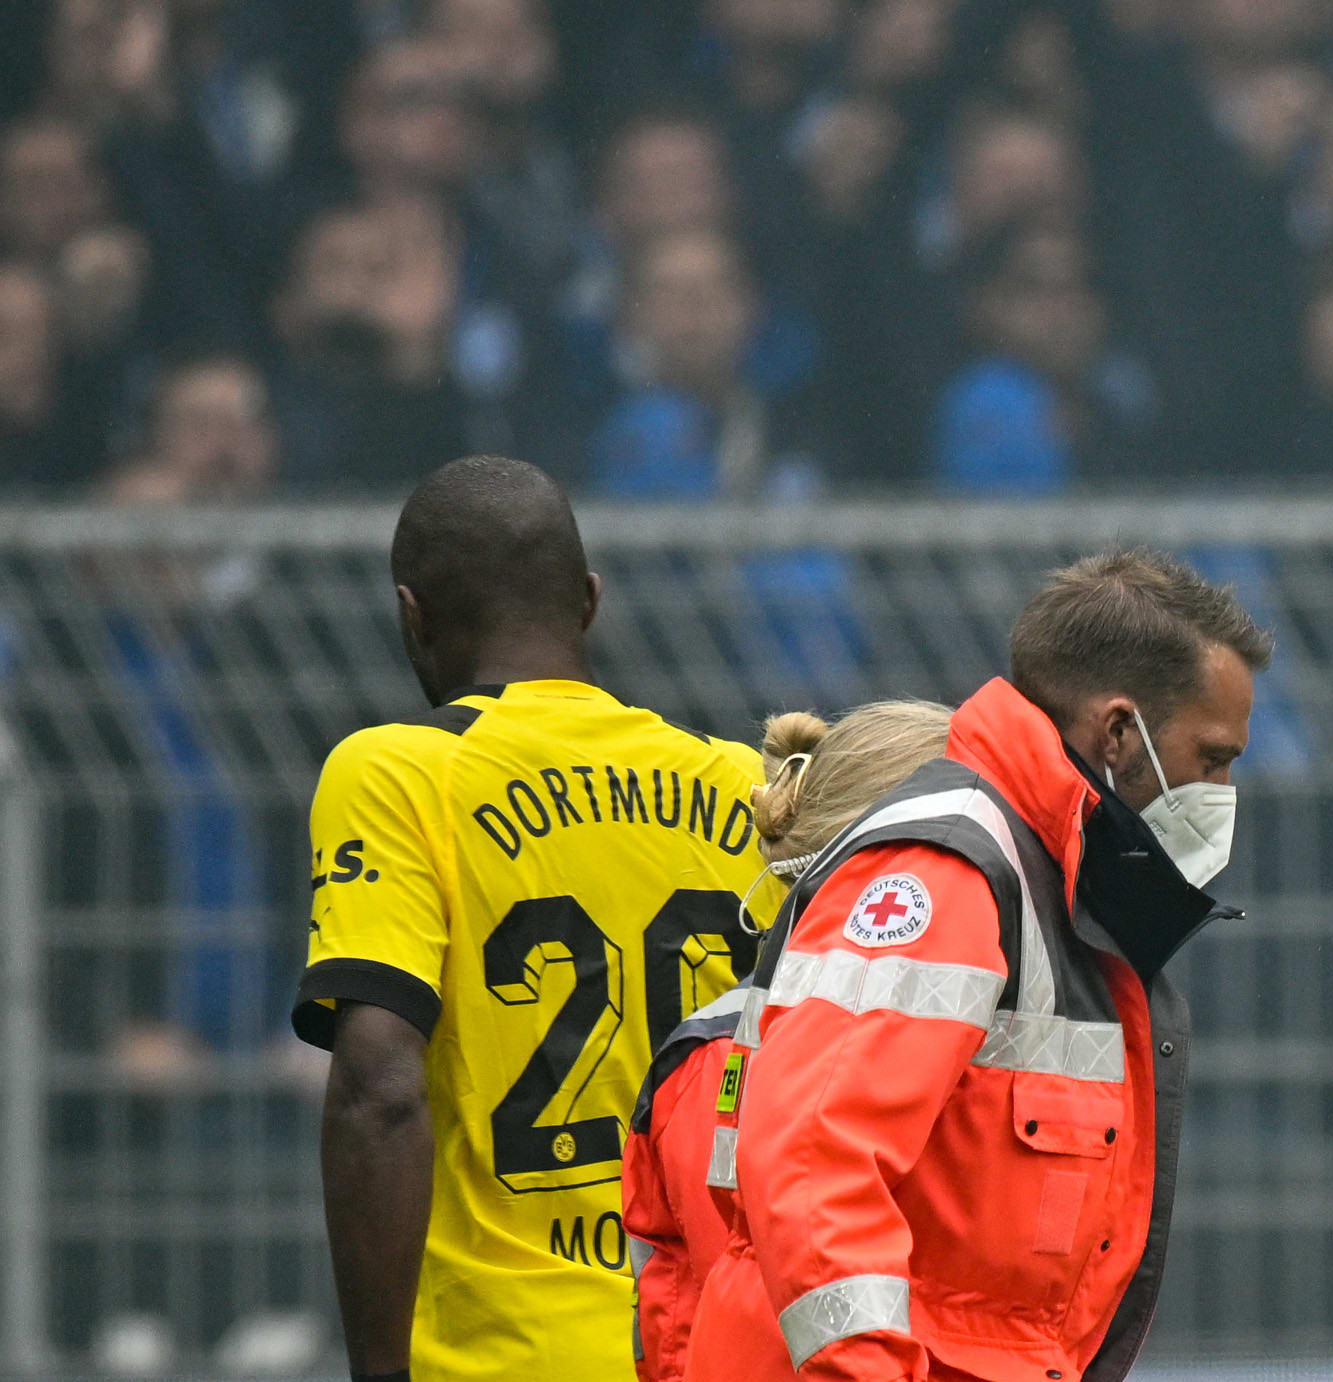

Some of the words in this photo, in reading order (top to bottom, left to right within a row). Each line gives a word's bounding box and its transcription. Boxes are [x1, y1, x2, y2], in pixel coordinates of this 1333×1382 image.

[472, 765, 753, 861] DORTMUND
[859, 879, 925, 909] DEUTSCHES
[877, 915, 922, 942] KREUZ
[550, 1210, 627, 1271] MO
